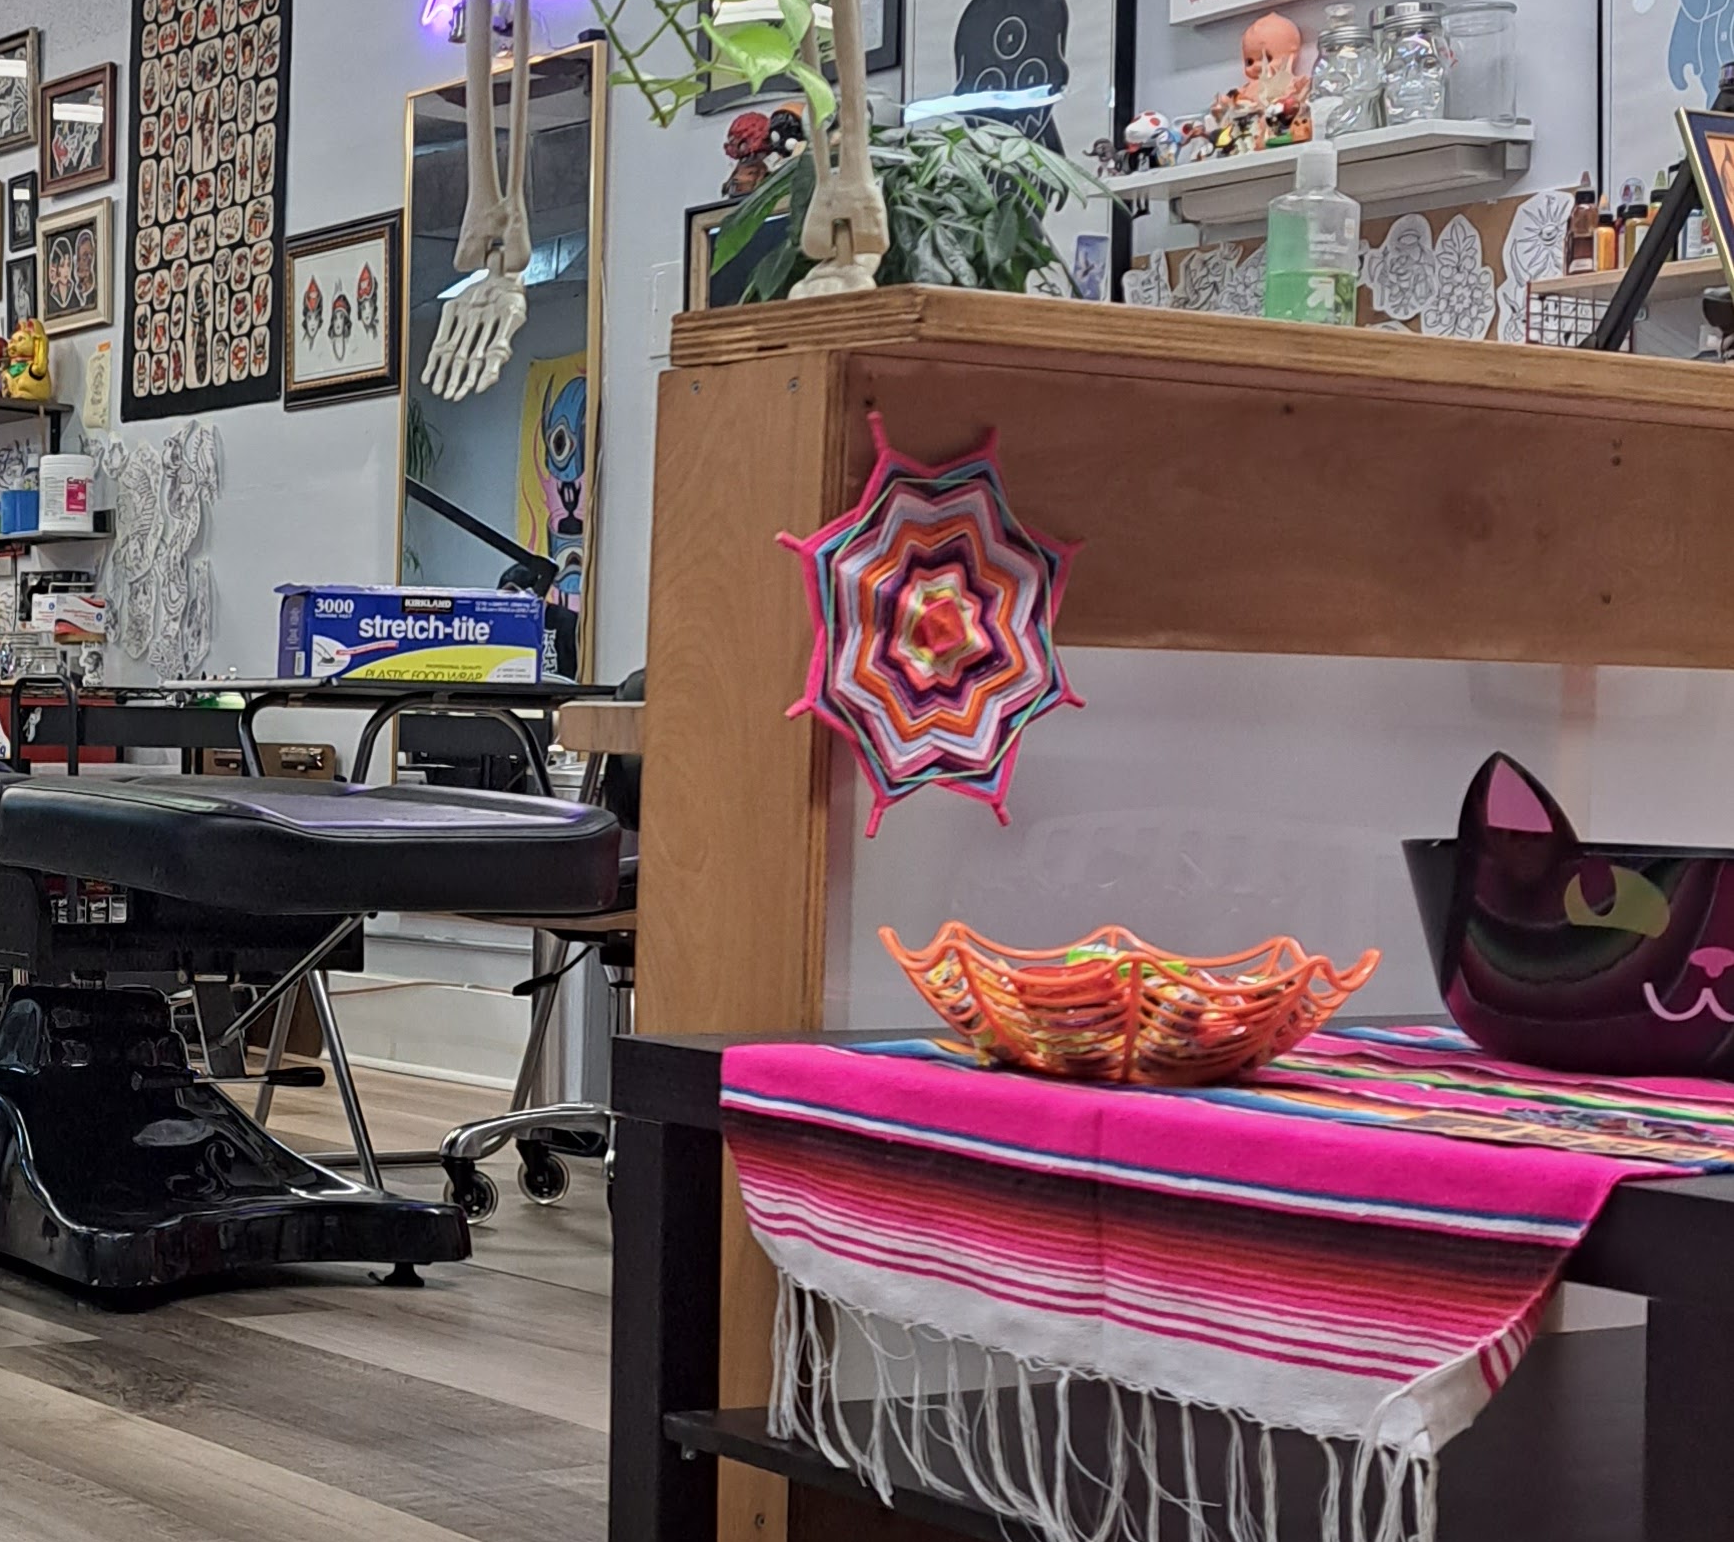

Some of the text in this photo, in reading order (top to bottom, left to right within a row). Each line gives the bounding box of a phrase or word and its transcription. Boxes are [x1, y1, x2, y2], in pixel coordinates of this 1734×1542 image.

[314, 598, 354, 614] 3000
[404, 598, 452, 609] KIRKLAND
[358, 614, 491, 642] stretch-tite
